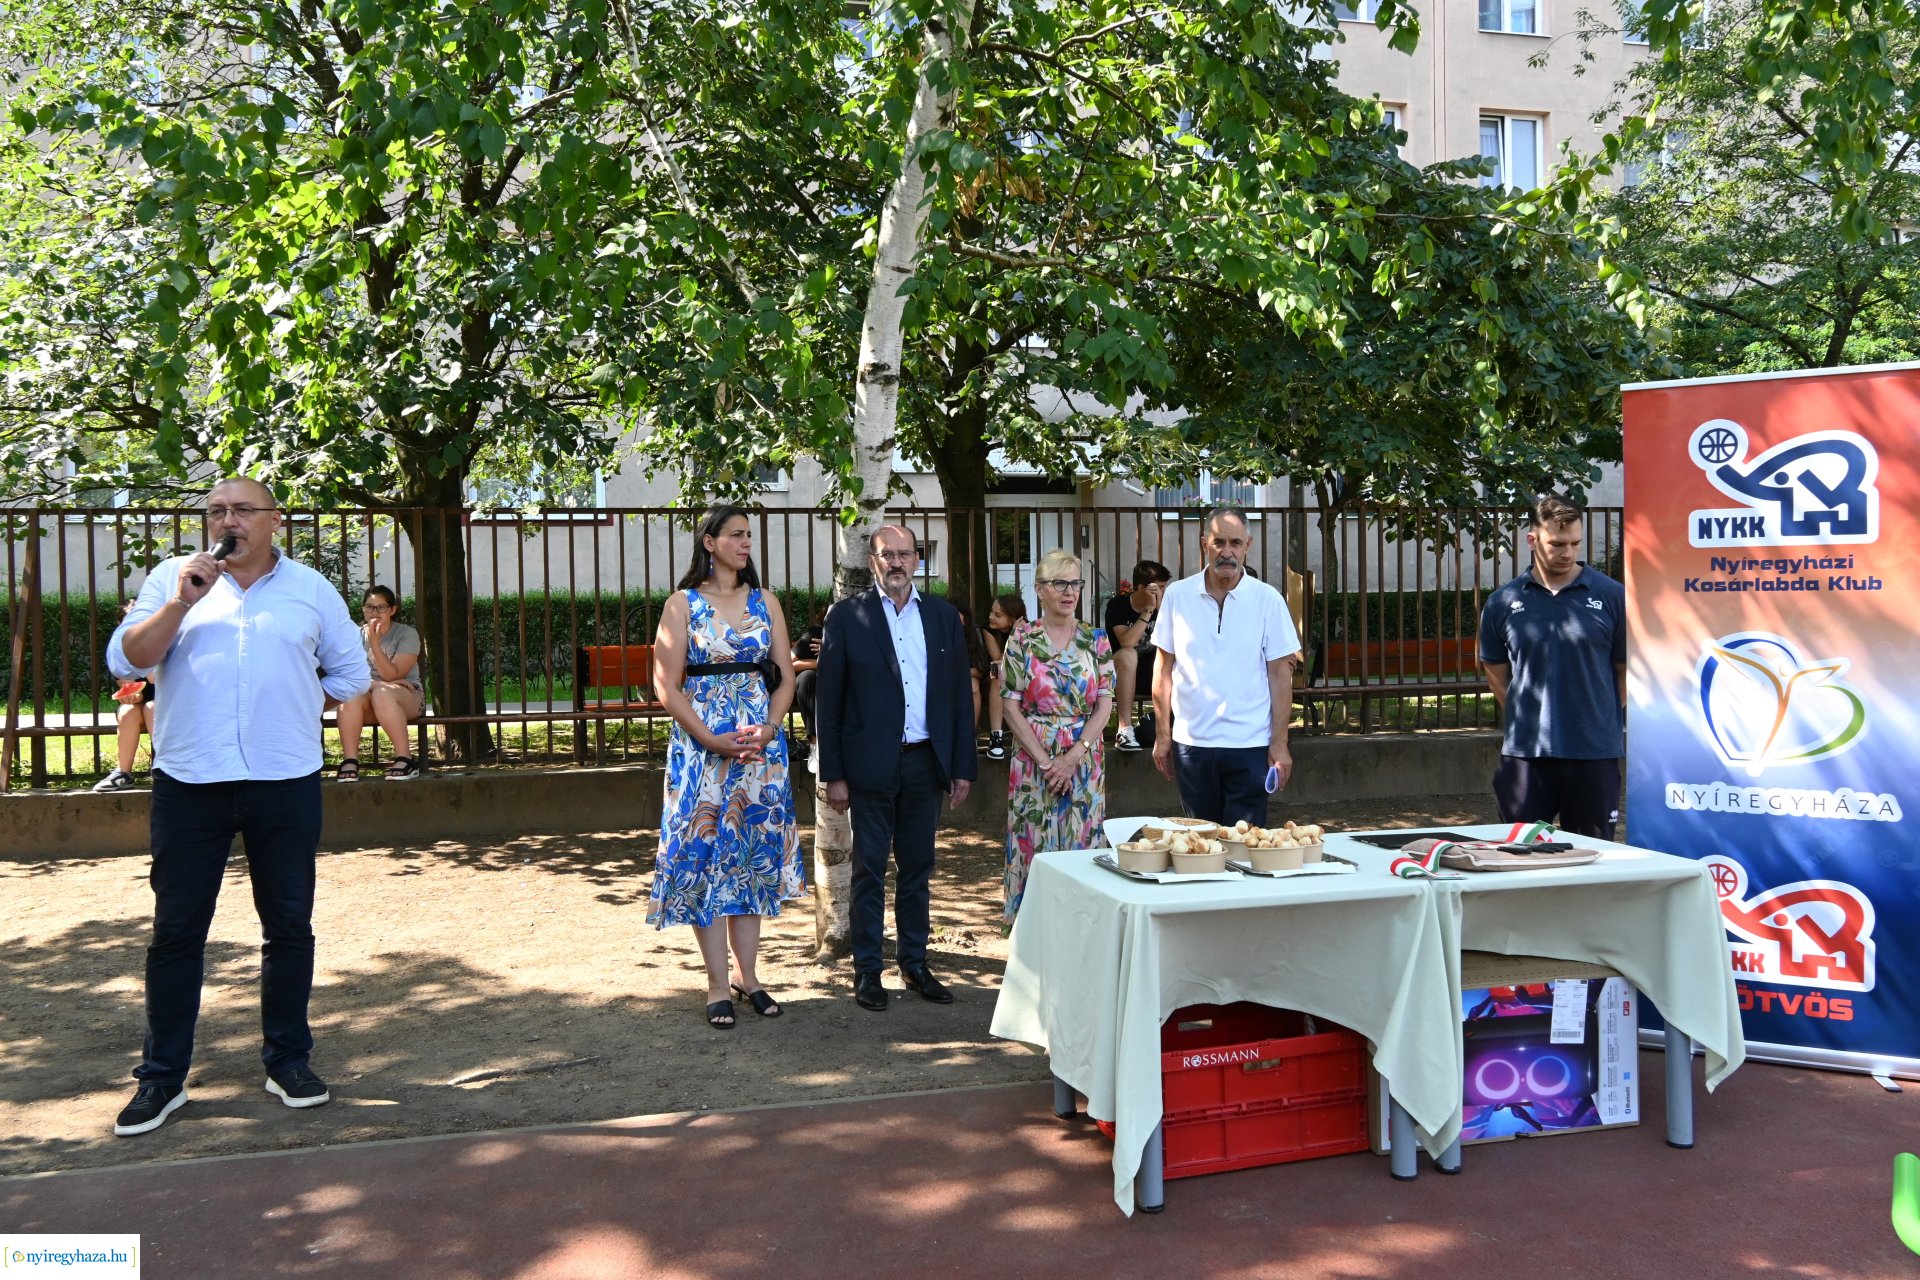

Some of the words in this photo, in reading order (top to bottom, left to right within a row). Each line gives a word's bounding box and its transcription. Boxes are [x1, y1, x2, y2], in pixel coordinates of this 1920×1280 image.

[1698, 516, 1765, 539] NYKK
[1710, 554, 1854, 575] Nyíregyházi
[1684, 577, 1819, 593] Kosárlabda
[1828, 576, 1883, 591] Klub
[1672, 788, 1895, 816] NYÍREGYHÁZA
[1731, 950, 1765, 974] KK
[1737, 984, 1854, 1022] ÖTVÖS
[1183, 1048, 1260, 1068] ROSSMANN
